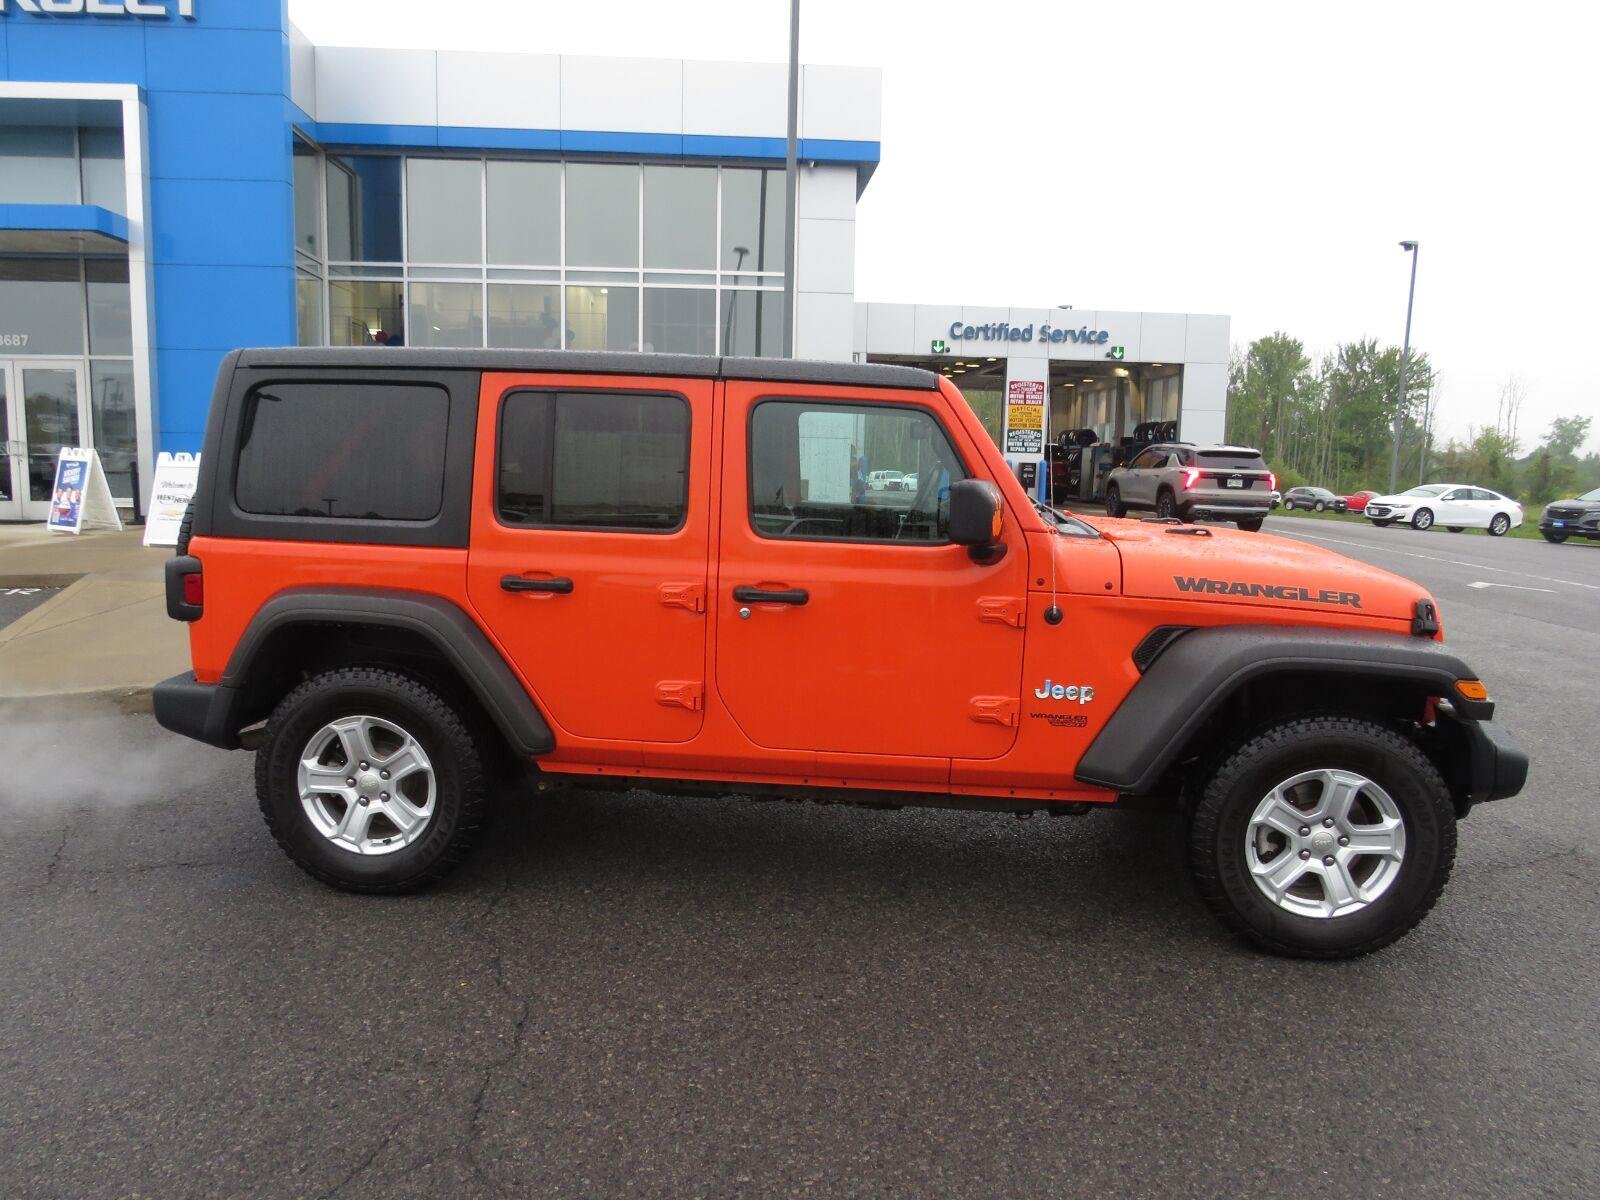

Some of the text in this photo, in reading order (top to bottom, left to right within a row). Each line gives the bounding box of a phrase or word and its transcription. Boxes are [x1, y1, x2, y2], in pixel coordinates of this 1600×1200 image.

[950, 321, 1109, 345] Certified Service
[1010, 381, 1043, 390] REGISTERED
[1008, 430, 1041, 438] REGISTERED
[1173, 575, 1363, 609] WRANGLER
[1034, 679, 1095, 705] Jeep
[1030, 712, 1088, 720] WRANGLER
